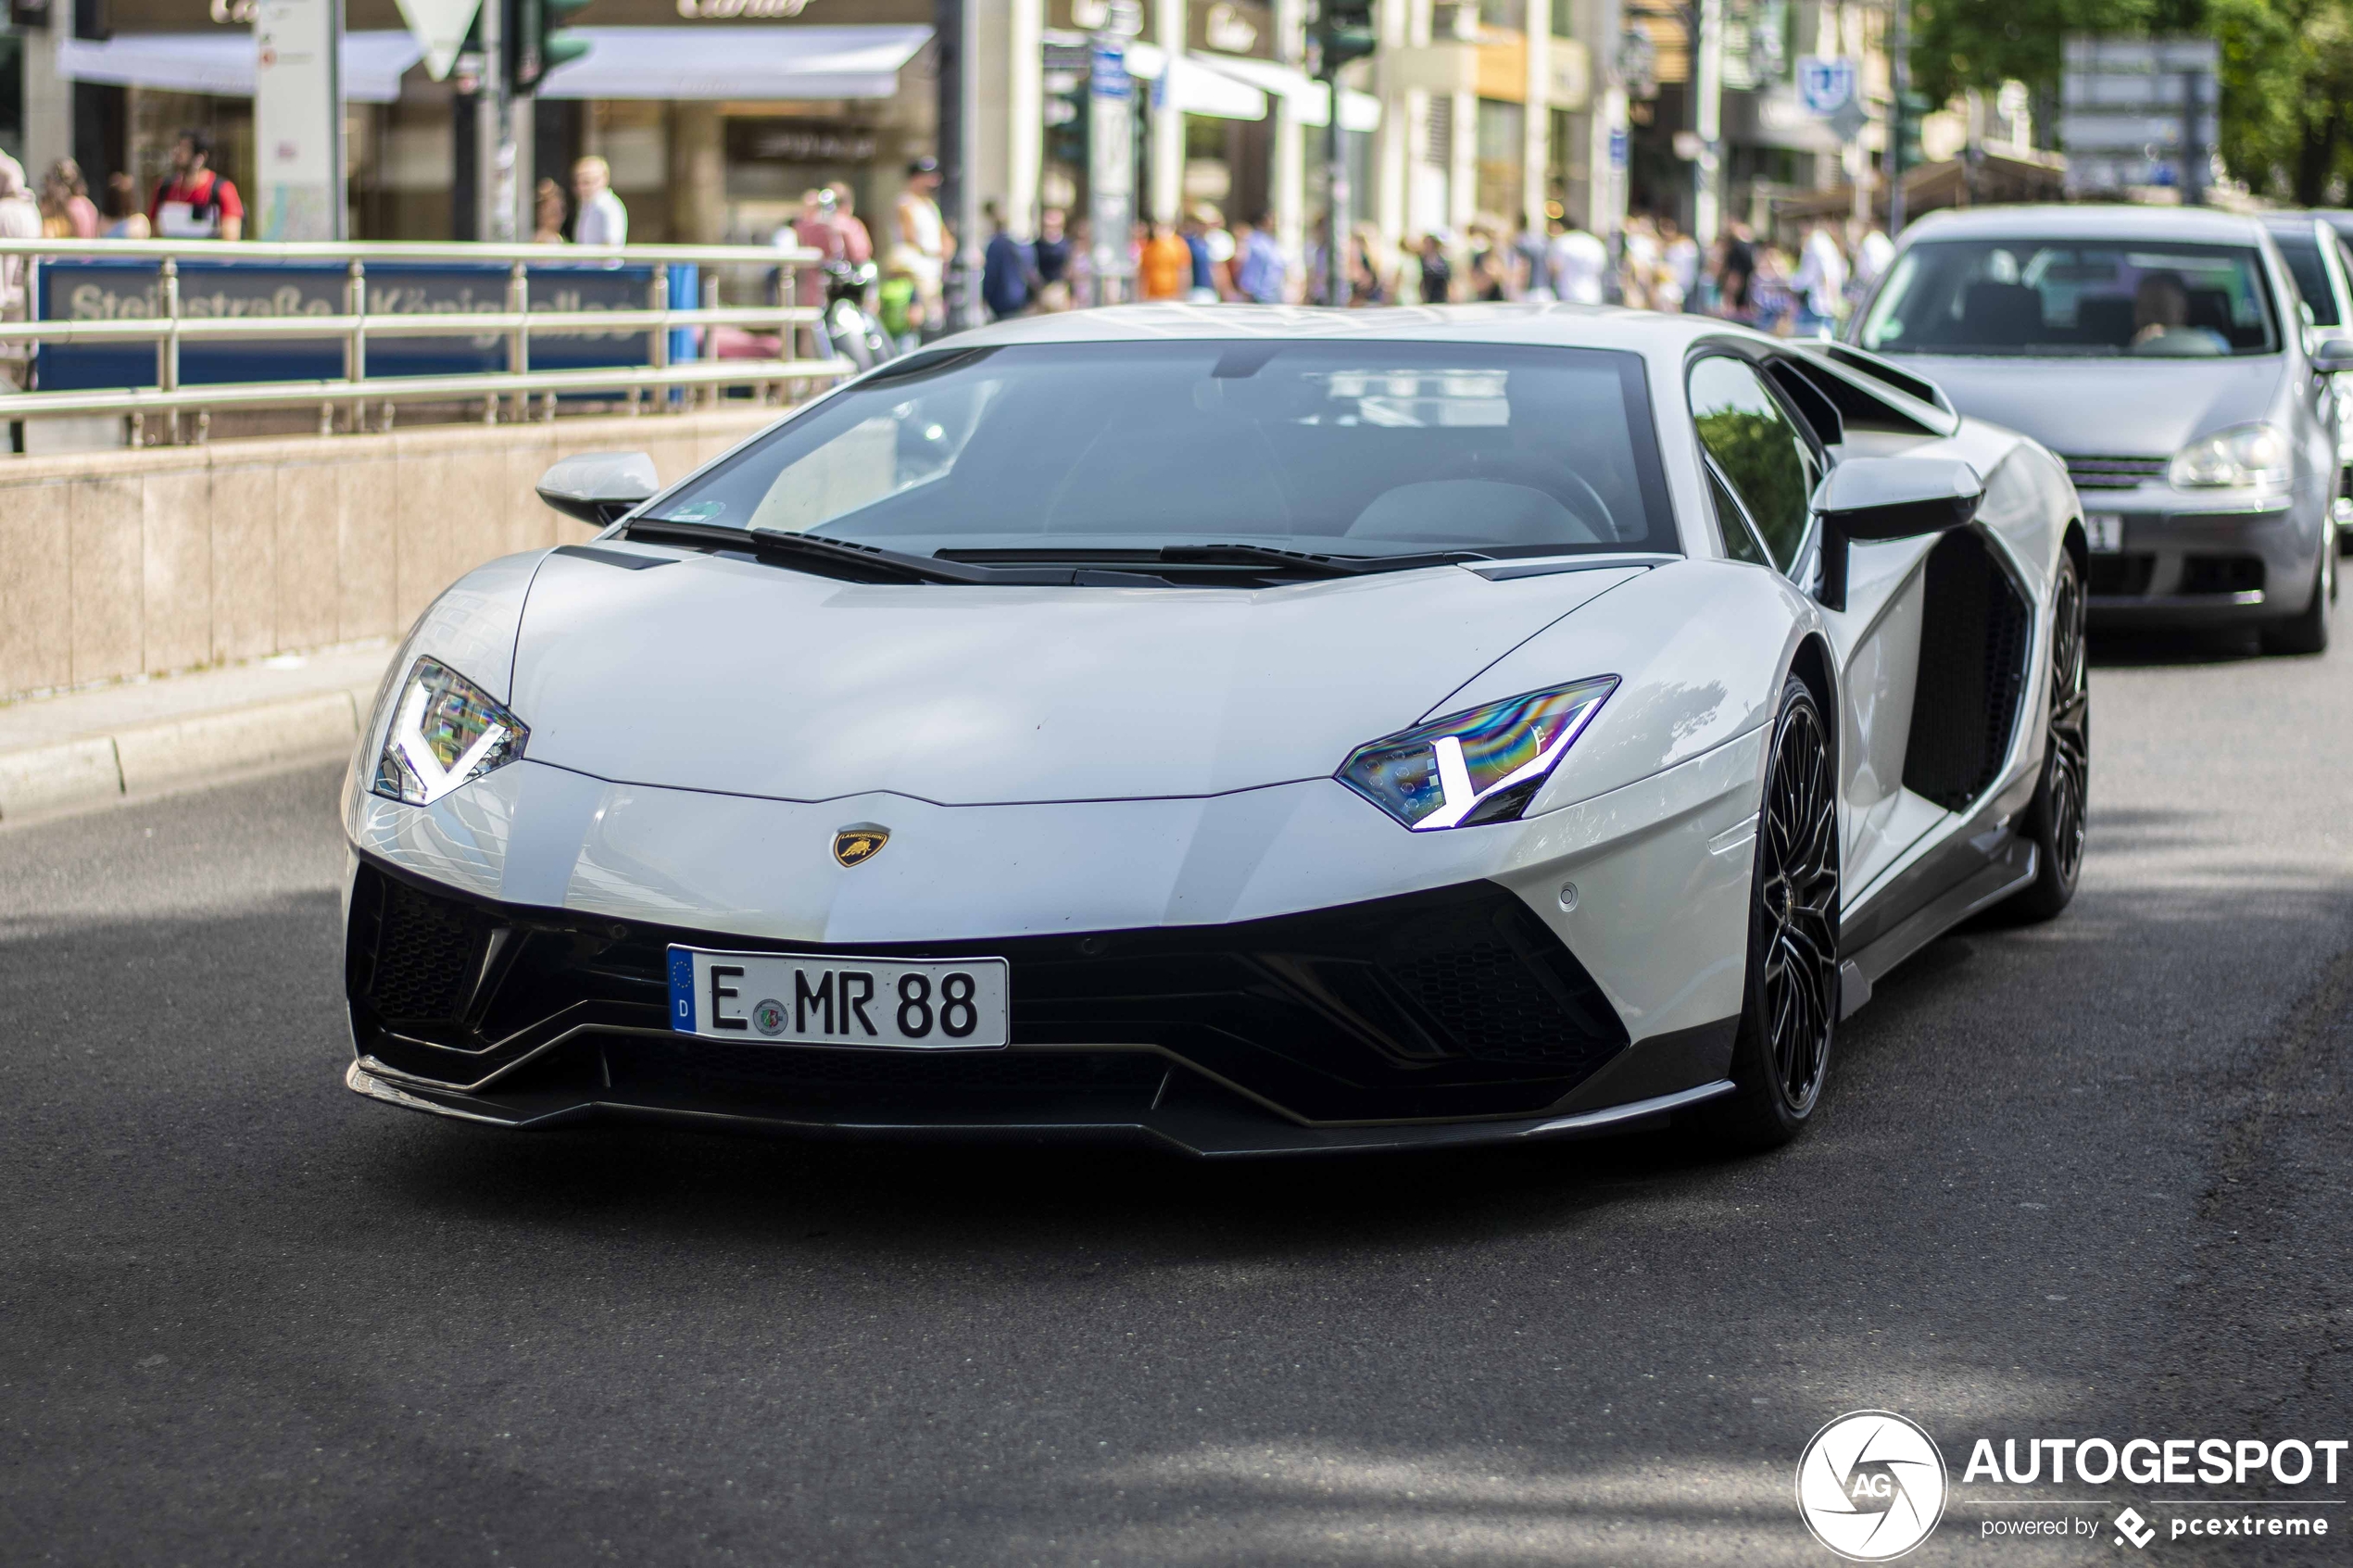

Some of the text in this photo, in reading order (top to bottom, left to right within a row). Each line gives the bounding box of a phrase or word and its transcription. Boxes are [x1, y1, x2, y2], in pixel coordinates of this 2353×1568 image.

[371, 288, 638, 349] Königallee
[679, 999, 688, 1017] D
[710, 964, 978, 1038] E MR 88
